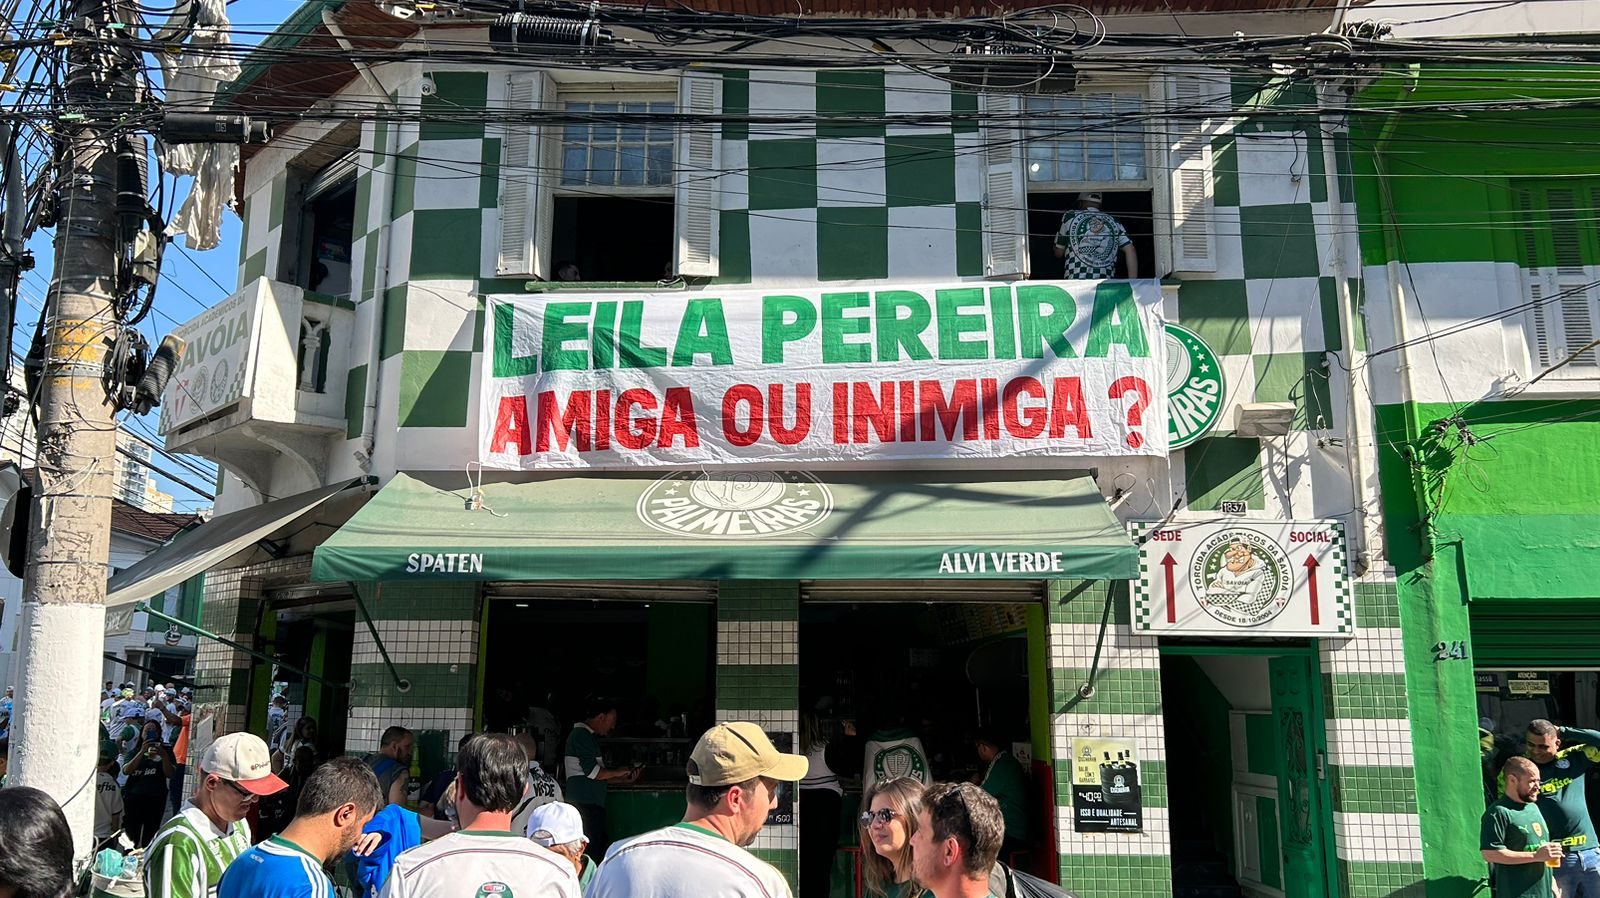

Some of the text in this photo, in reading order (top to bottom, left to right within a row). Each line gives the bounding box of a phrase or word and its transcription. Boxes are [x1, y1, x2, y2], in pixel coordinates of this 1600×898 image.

[492, 281, 1151, 378] LEILA PEREIRA
[175, 310, 249, 375] AVÓIA
[490, 375, 1154, 456] AMIGA OU INIMIGA ?
[651, 496, 822, 535] PALMEIRAS
[1152, 530, 1182, 542] SEDE
[1289, 531, 1331, 543] SOCIAL
[405, 552, 484, 573] SPATEN
[938, 551, 1065, 574] ALVI VERDE
[1193, 550, 1208, 591] TORCIDA
[1267, 544, 1279, 556] DA
[1214, 609, 1237, 623] DESDE
[1433, 640, 1468, 662] 241
